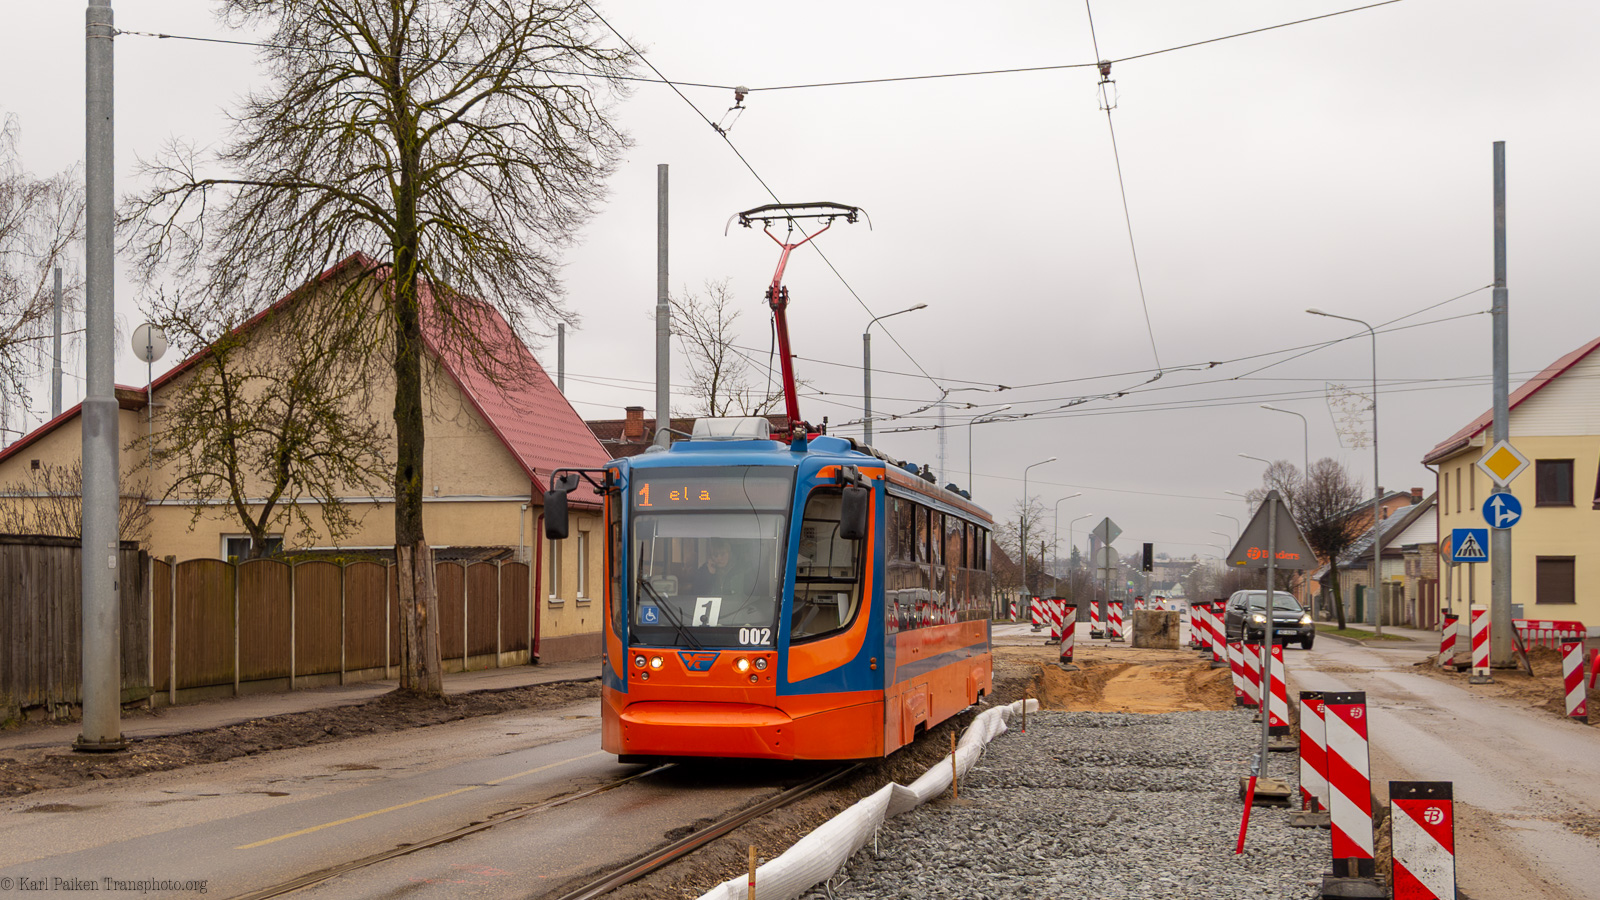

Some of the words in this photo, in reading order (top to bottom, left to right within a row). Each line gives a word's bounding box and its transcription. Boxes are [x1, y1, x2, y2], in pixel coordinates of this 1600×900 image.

[639, 483, 652, 507] 1
[700, 600, 713, 626] 1
[738, 627, 771, 646] 002
